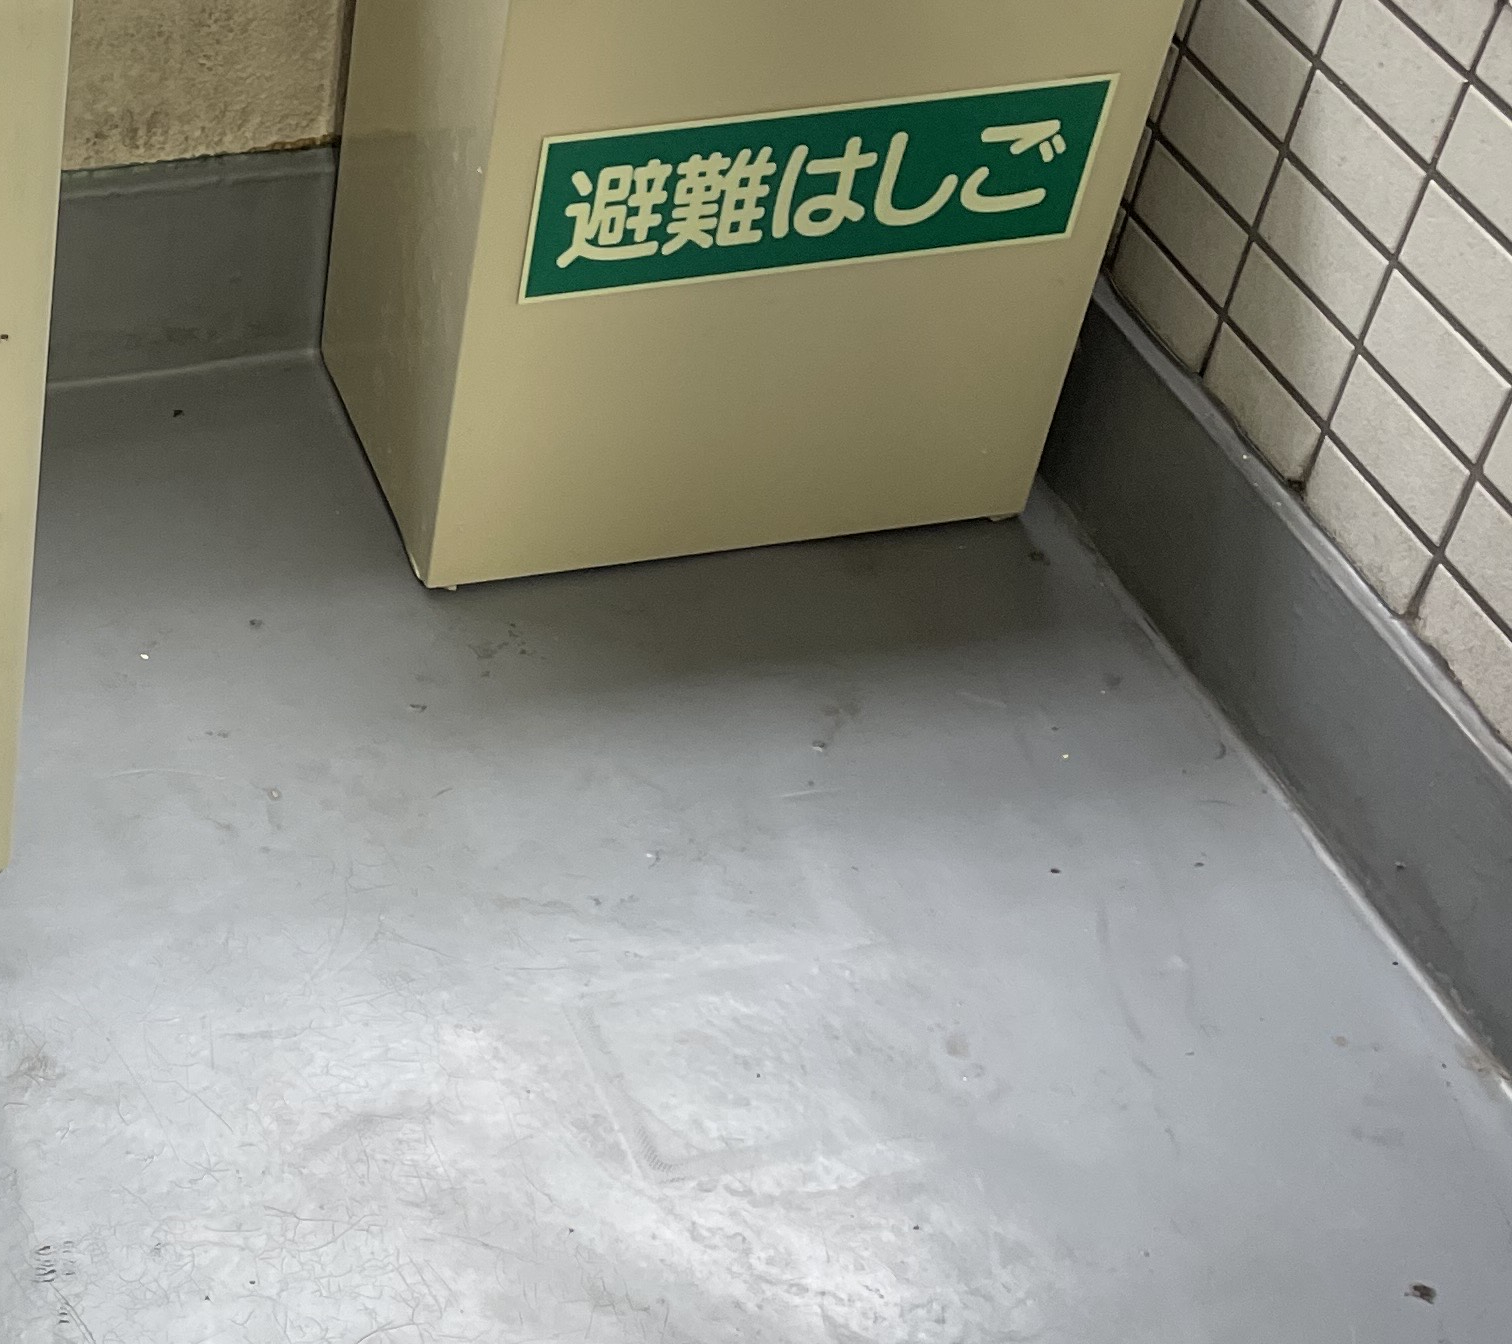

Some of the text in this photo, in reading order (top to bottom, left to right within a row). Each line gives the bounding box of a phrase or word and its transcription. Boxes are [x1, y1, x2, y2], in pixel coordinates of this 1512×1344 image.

[555, 118, 1067, 268] 避難はしご
